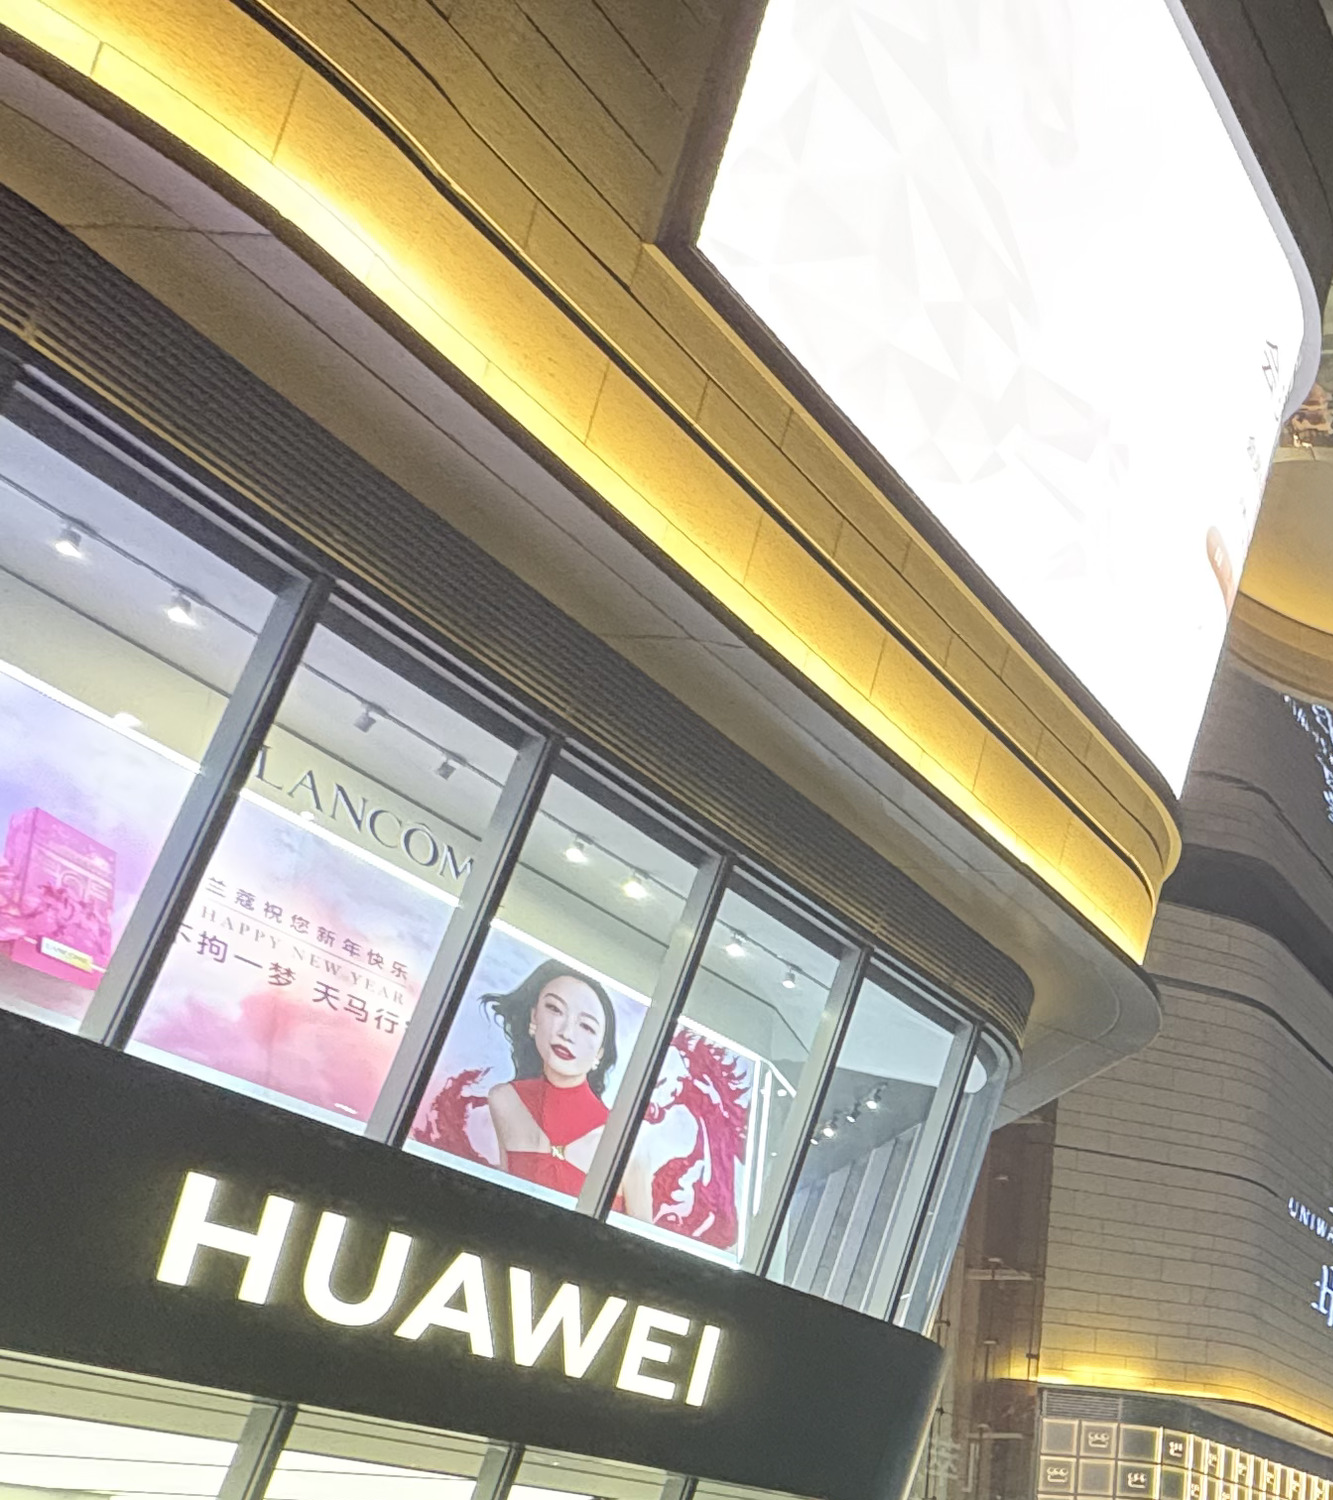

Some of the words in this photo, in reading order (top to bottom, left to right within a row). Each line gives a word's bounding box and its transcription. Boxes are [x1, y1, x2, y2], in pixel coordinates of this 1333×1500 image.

[201, 905, 282, 950] HAPPY
[292, 945, 342, 979] NEW
[349, 970, 405, 1006] YEAR
[205, 876, 409, 982] 兰蔻祝您新年快乐
[312, 980, 411, 1035] 天马行
[156, 1170, 721, 1407] HUAWEI
